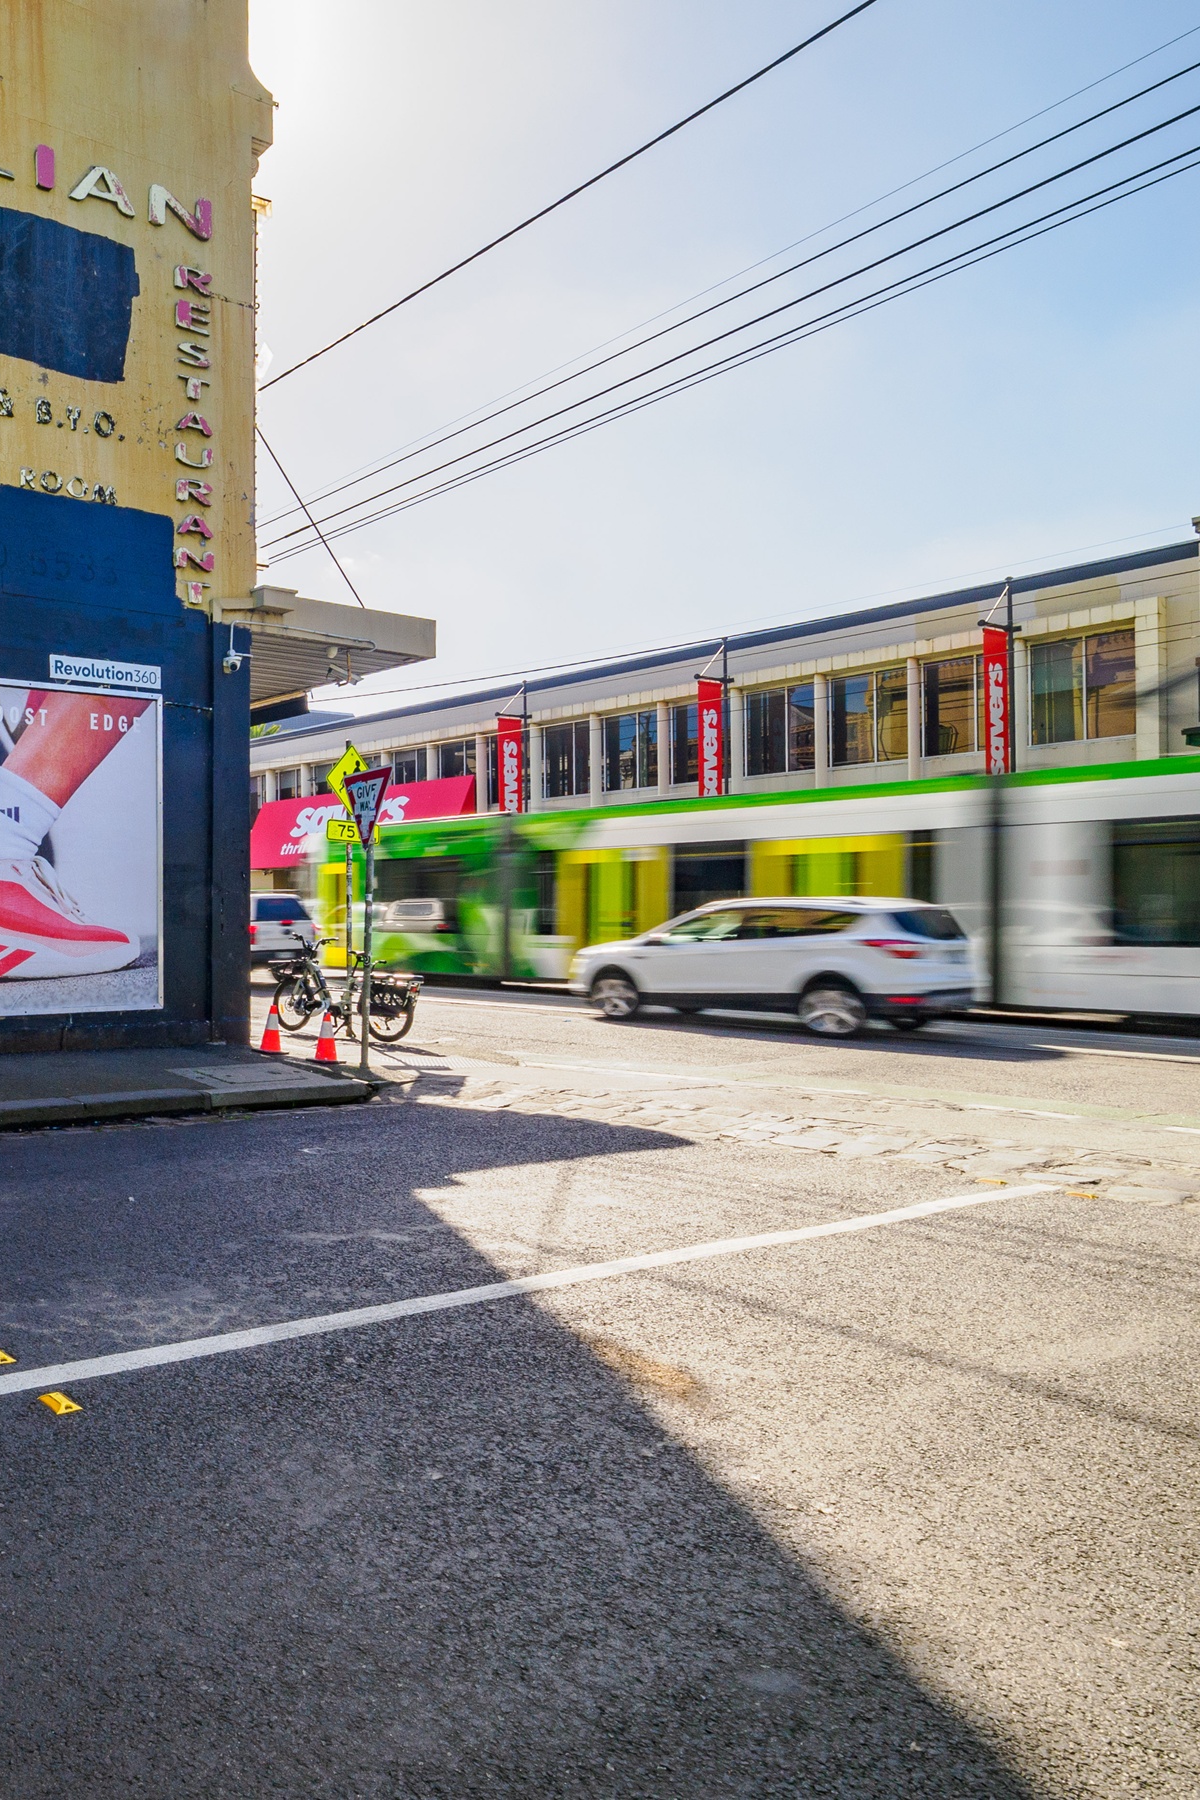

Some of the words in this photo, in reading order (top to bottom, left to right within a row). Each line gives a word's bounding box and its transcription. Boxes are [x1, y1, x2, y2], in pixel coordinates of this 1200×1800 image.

[35, 397, 126, 442] B.Y.O.
[173, 264, 215, 604] RESTAURANT
[19, 467, 118, 506] ROOM
[53, 659, 158, 685] Revolution360
[89, 712, 142, 734] EDGE
[289, 795, 410, 838] savrs
